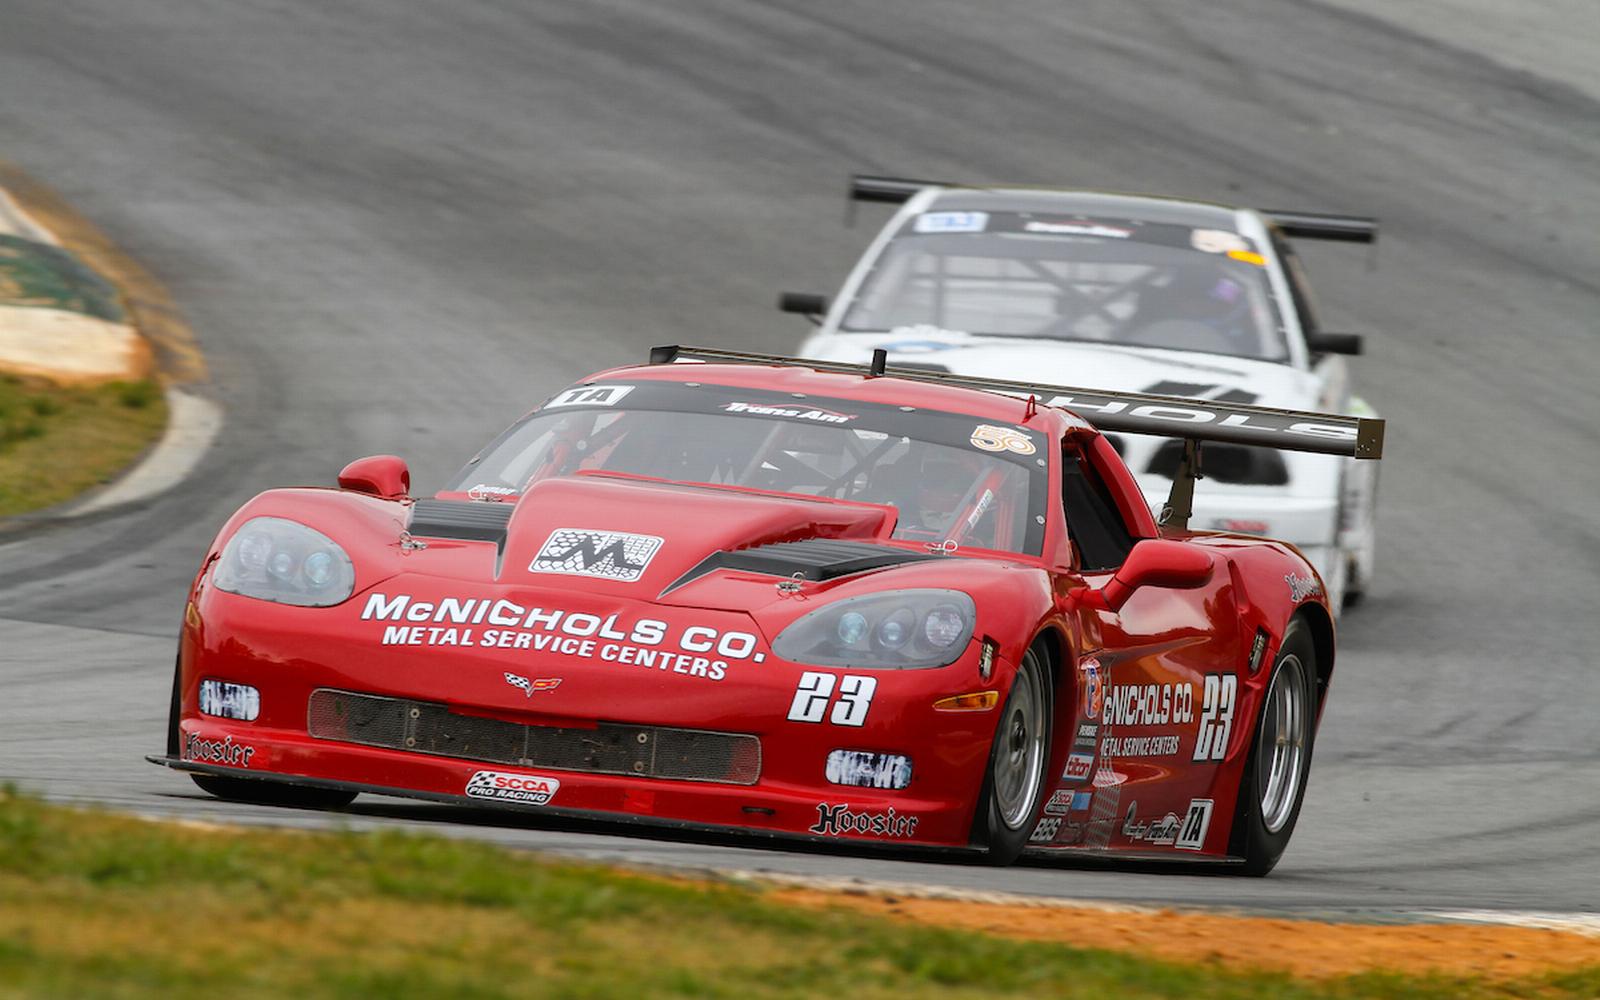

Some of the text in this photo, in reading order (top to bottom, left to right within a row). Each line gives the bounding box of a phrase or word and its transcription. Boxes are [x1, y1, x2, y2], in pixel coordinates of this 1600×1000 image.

[563, 388, 615, 403] TA
[725, 402, 849, 423] Trans Am
[361, 593, 768, 663] McNICHOLS CO.
[382, 626, 729, 682] METAL SERVICE CENTERS
[786, 671, 878, 728] 23
[1172, 682, 1194, 723] CO.
[1192, 674, 1238, 761] 23
[183, 731, 256, 768] Hoosier
[1121, 736, 1151, 757] SERVICE
[1149, 735, 1180, 755] CENTERS
[469, 786, 548, 802] PRO RACING
[494, 777, 551, 793] SCCA
[808, 802, 920, 837] Hoosier
[1030, 818, 1062, 841] BBS
[1182, 806, 1206, 842] TA
